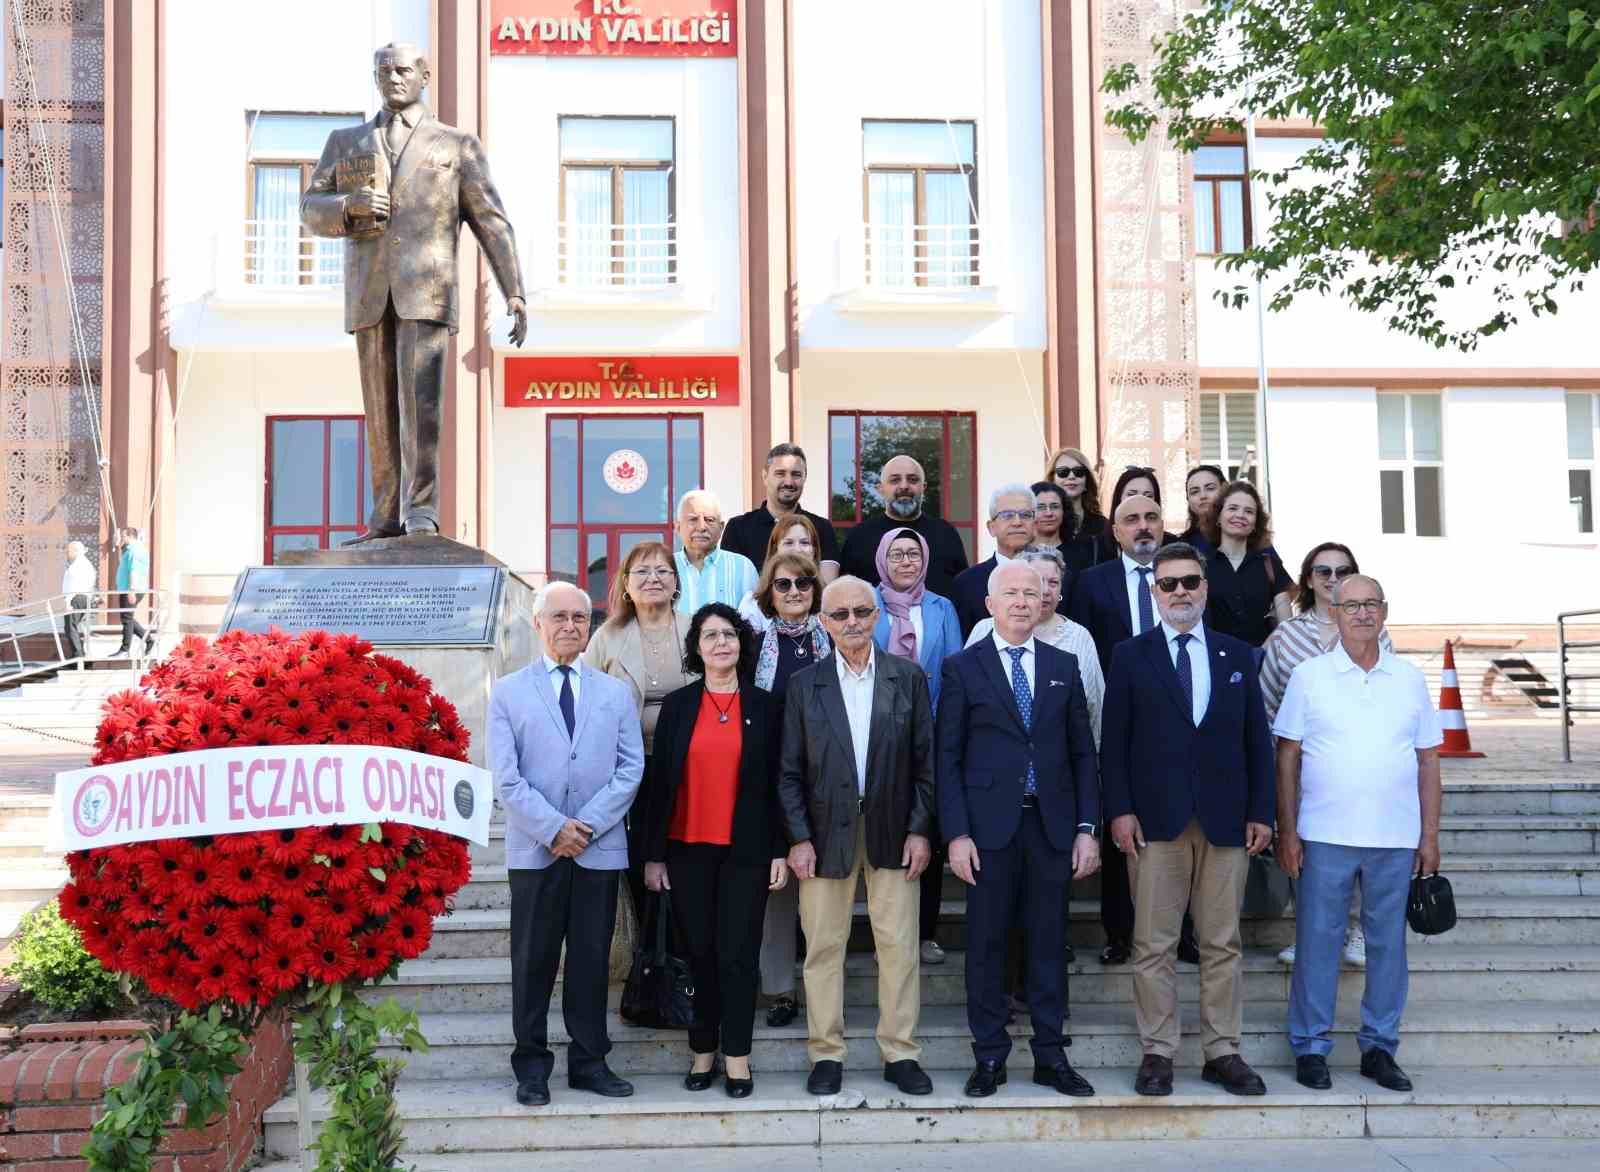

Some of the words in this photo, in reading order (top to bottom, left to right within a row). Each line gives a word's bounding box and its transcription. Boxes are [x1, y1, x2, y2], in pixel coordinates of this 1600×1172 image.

[497, 16, 592, 42] AYDIN
[602, 12, 730, 43] VALİLİĞİ
[598, 362, 644, 380] T.C.
[524, 382, 601, 400] AYDIN
[609, 377, 718, 399] VALİLİĞİ
[115, 764, 206, 833] AYDIN
[227, 757, 345, 821] ECZACI
[362, 757, 447, 821] ODASI
